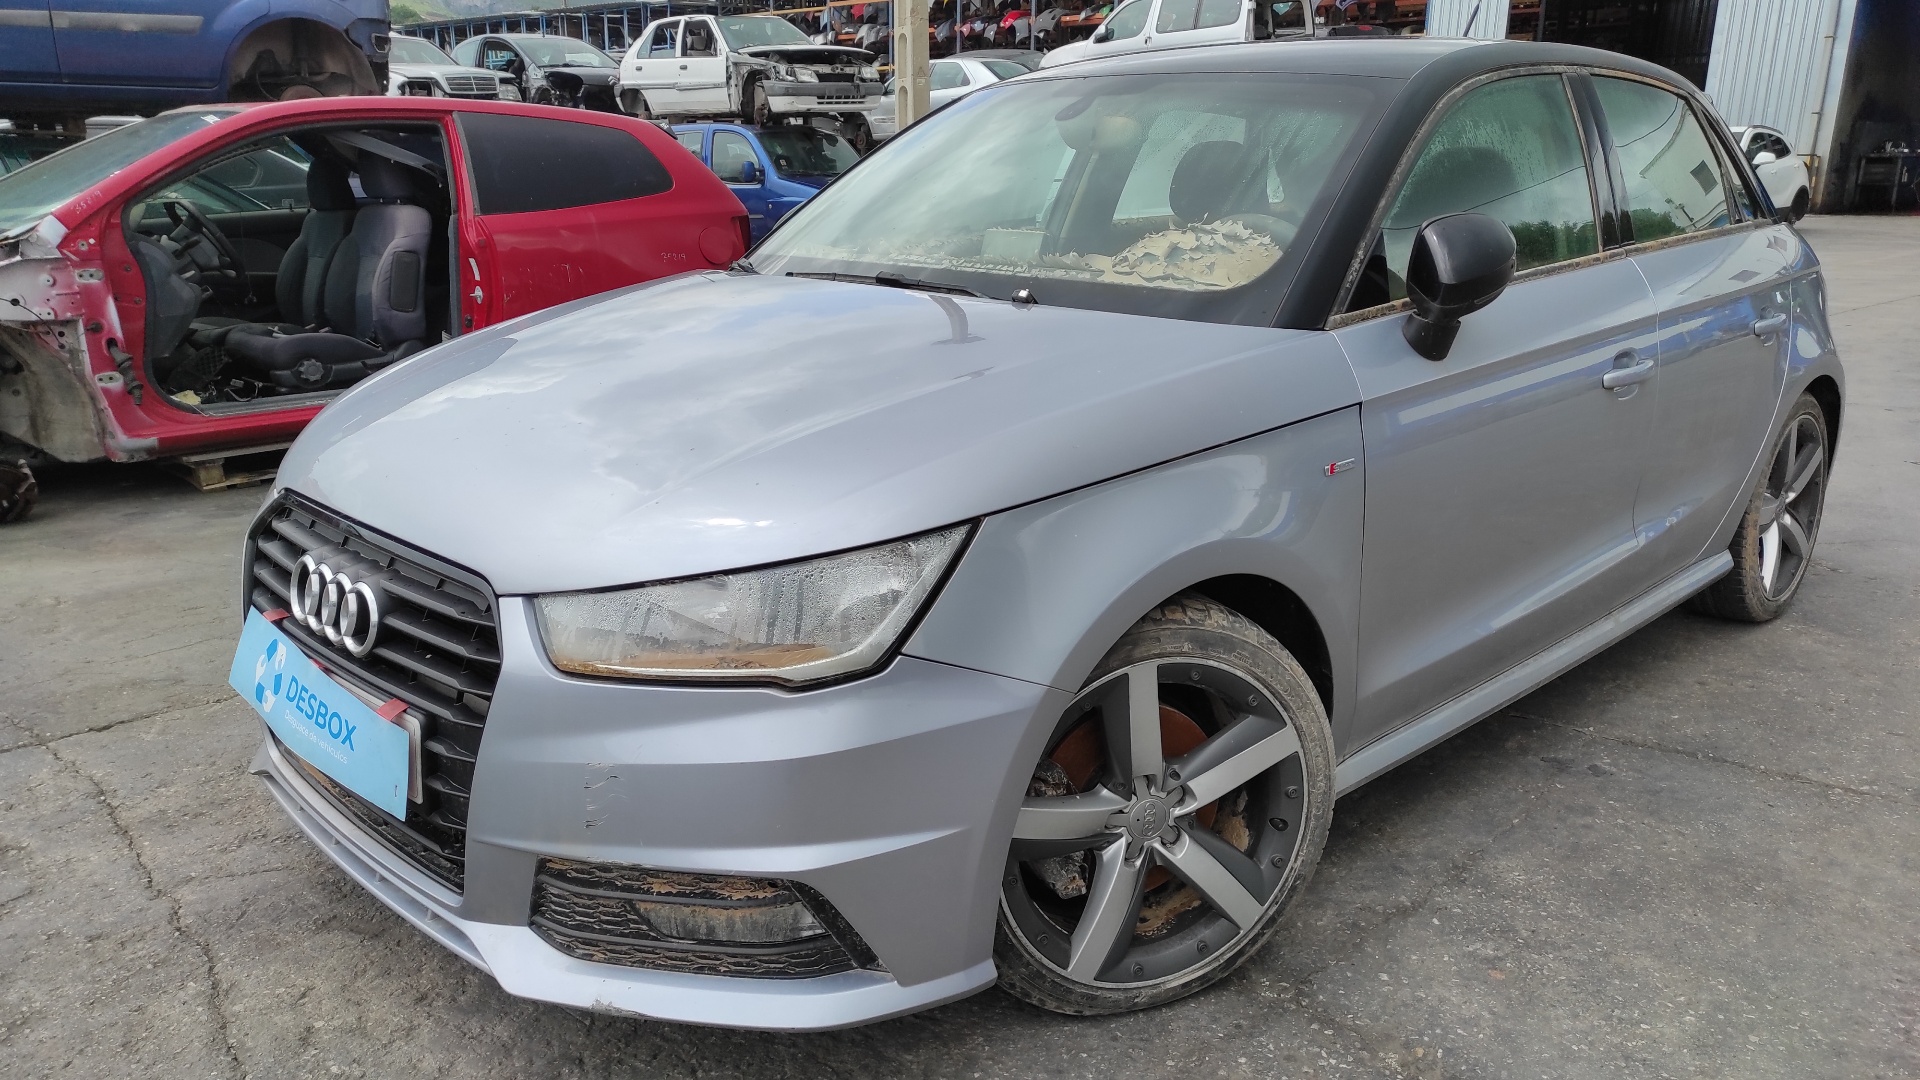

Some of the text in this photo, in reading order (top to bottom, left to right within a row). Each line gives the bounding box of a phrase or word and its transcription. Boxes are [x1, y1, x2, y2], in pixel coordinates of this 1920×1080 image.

[284, 709, 309, 737] Desguace
[309, 731, 318, 743] de
[285, 674, 357, 752] DESBOX
